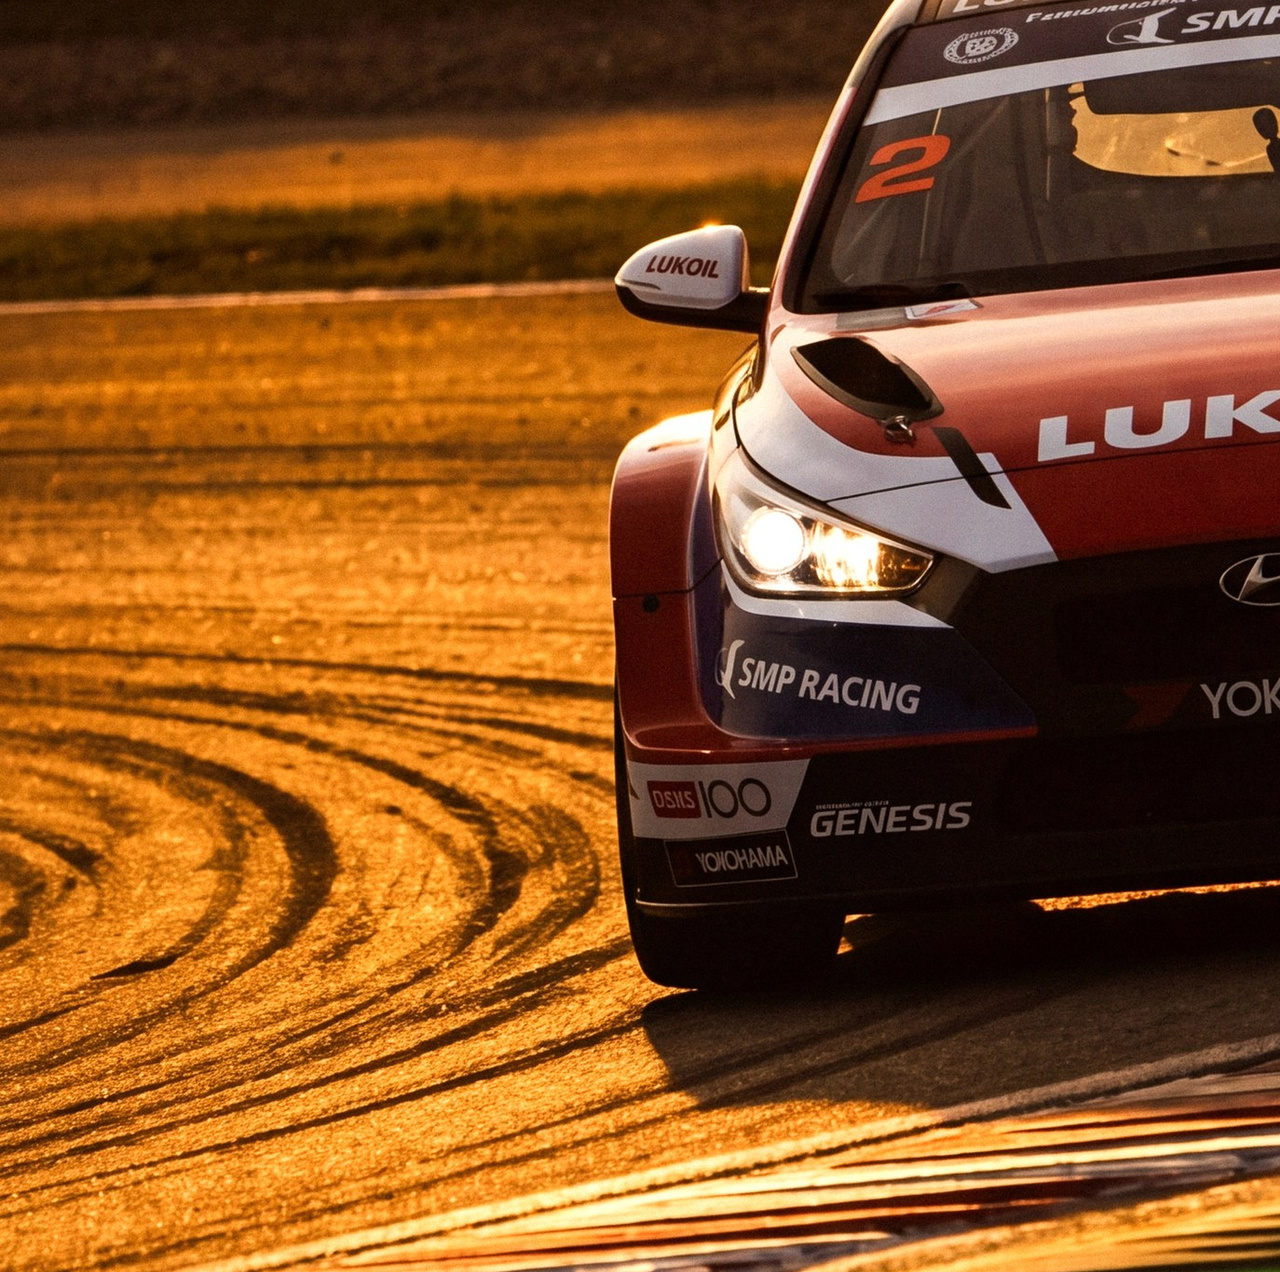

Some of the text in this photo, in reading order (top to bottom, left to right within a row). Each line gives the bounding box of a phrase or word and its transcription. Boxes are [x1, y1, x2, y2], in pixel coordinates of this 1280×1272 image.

[855, 134, 951, 204] 2
[645, 255, 719, 279] LUKOIL
[738, 657, 922, 715] SMP RACING
[810, 801, 973, 838] GENESIS
[695, 844, 789, 873] YOKOHAMA
